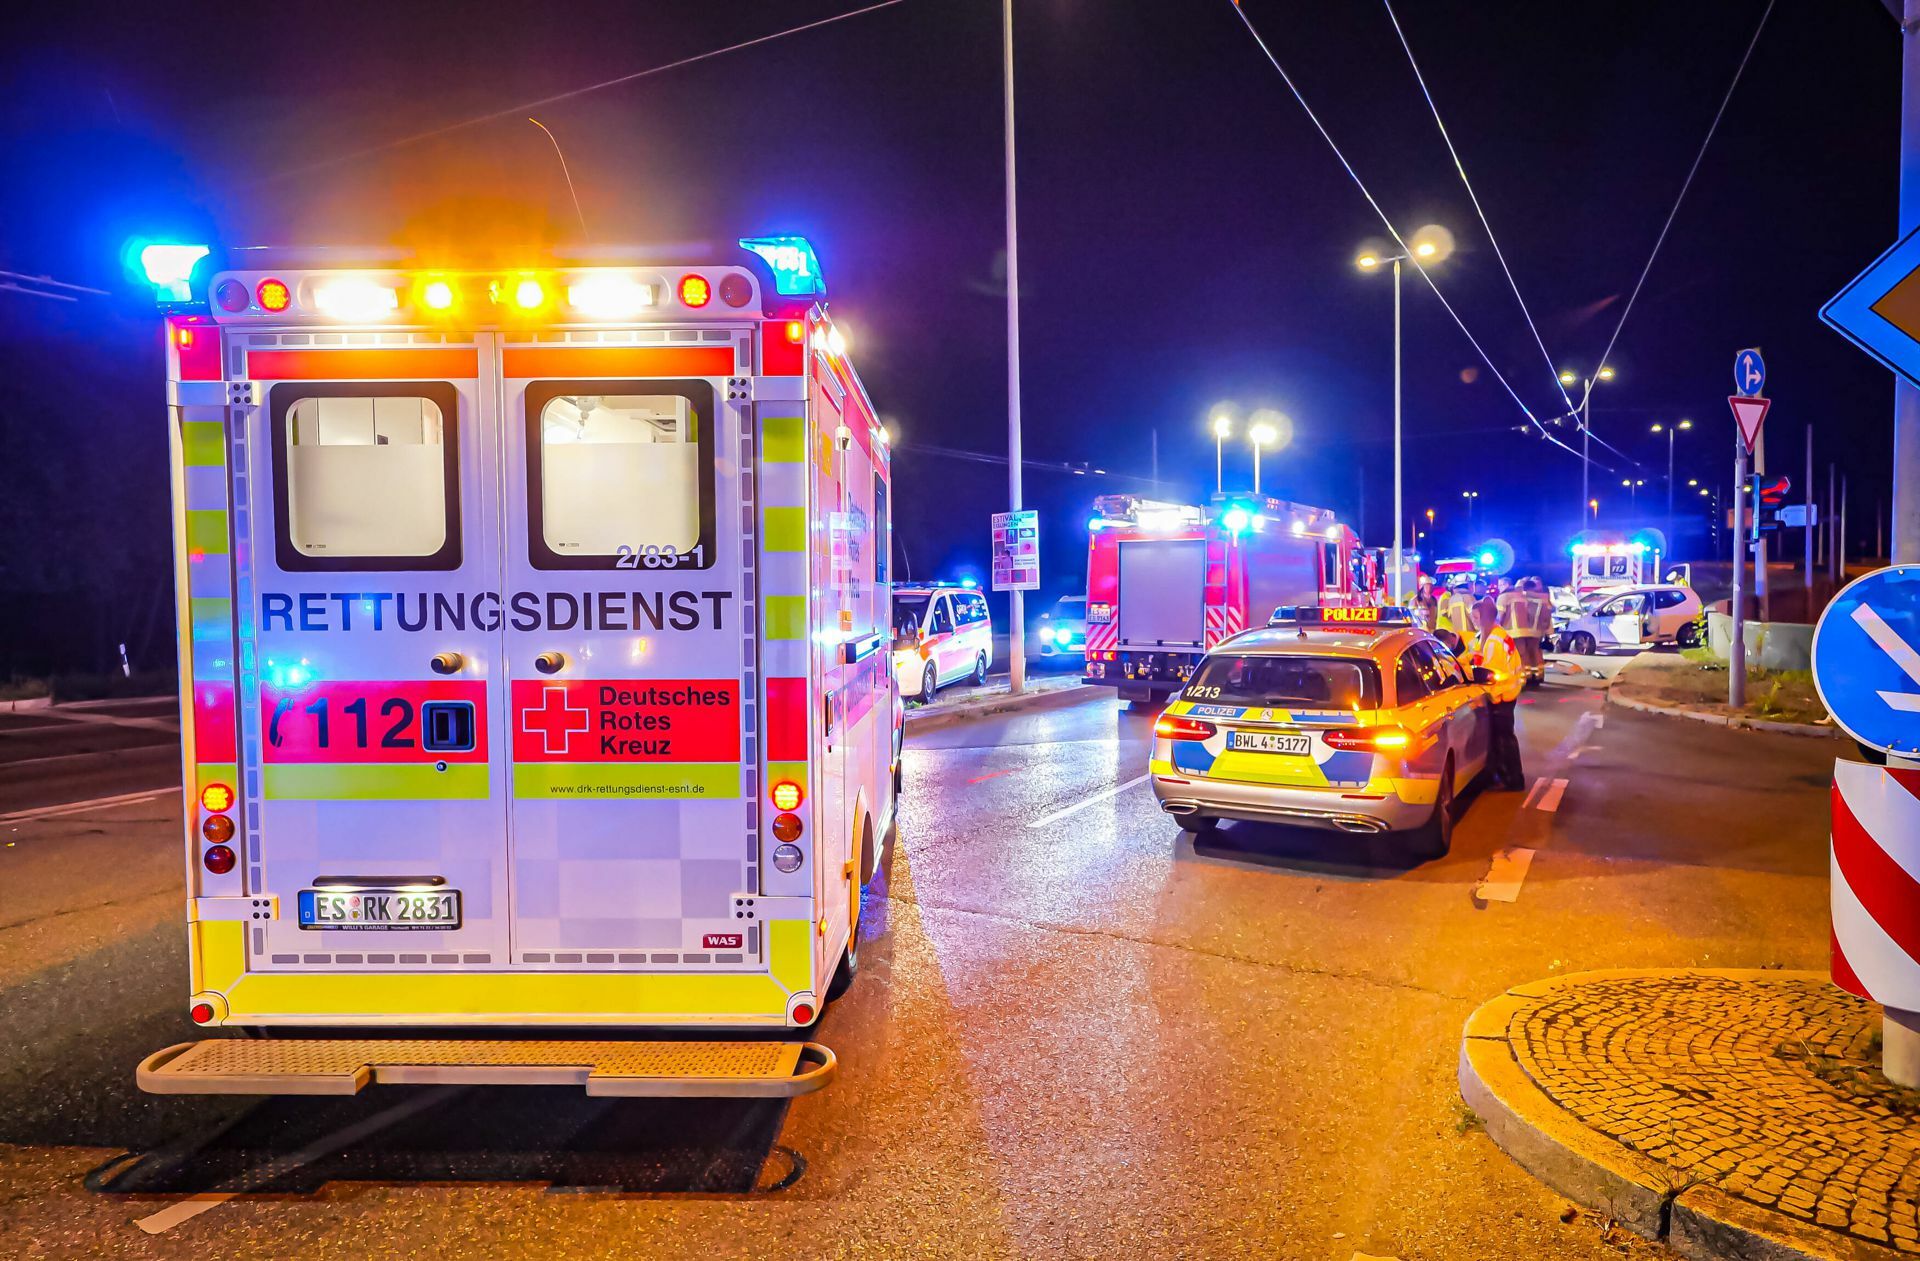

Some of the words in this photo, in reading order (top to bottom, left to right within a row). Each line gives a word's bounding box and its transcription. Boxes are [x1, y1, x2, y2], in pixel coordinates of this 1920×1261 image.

[616, 544, 704, 569] 2/83-1
[262, 591, 733, 632] RETTUNGSDIENST
[1323, 607, 1378, 622] POLIZEI
[600, 686, 731, 706] Deutsches
[1186, 685, 1221, 699] 1/213
[600, 711, 671, 731] Rotes
[1197, 706, 1237, 716] POLIZEI
[306, 697, 415, 749] 112
[600, 735, 671, 755] Kreuz
[1235, 734, 1258, 749] BWL
[1277, 737, 1308, 752] 5177
[550, 783, 705, 796] www.drk-rettungsdienst-esnt.de
[316, 896, 346, 921] ES
[363, 896, 392, 921] RK
[397, 896, 455, 921] 2831
[708, 936, 737, 946] WAS
